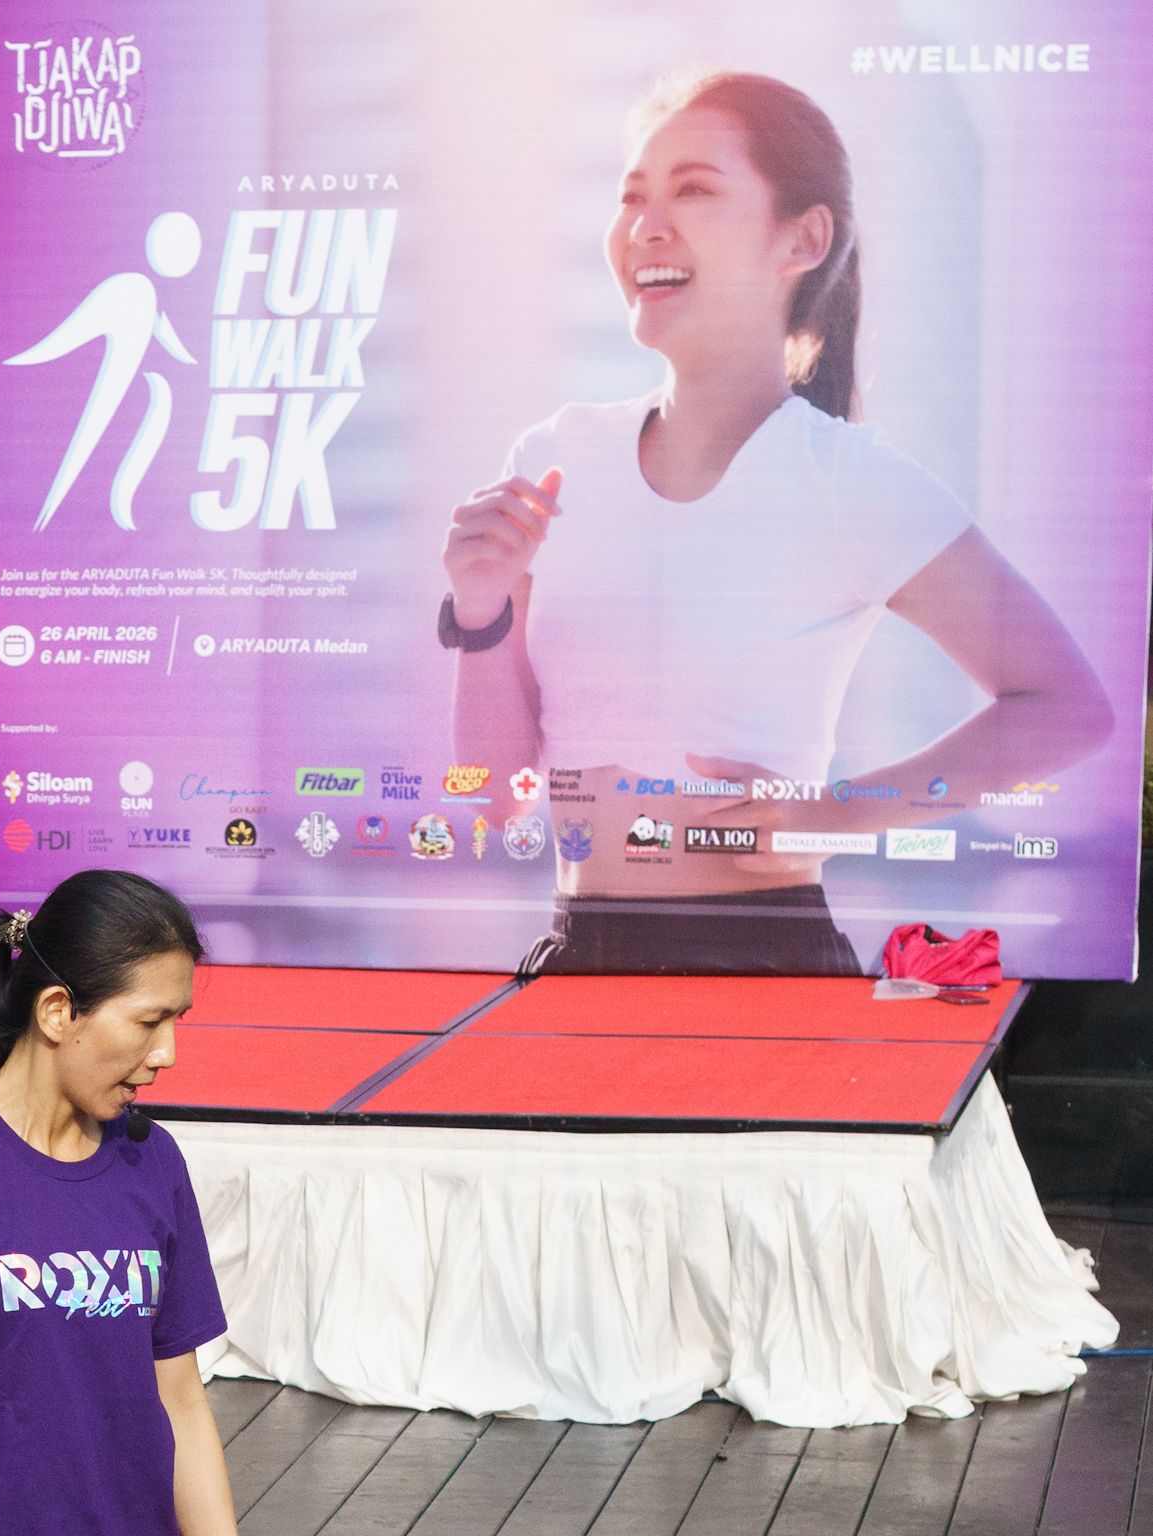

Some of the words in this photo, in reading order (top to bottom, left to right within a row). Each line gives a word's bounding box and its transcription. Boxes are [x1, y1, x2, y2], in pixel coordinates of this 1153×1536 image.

[4, 35, 141, 98] TJAKAP
[850, 44, 1090, 74] #WELLNICE
[237, 173, 400, 192] ARYADUTA
[212, 208, 398, 316] FUN
[209, 317, 377, 389] WALK
[189, 392, 361, 532] 5K
[0, 568, 24, 581] Join
[26, 570, 39, 581] us
[41, 568, 58, 582] for
[60, 568, 79, 581] the
[81, 568, 149, 581] ARYADUTA
[151, 568, 174, 580] Fun
[177, 568, 206, 580] Walk
[232, 568, 304, 582] Thoughtfully
[305, 568, 358, 582] designed
[0, 585, 13, 596] to
[15, 584, 62, 598] energize
[64, 587, 90, 598] your
[126, 584, 166, 597] refresh
[168, 586, 194, 598] your
[230, 584, 253, 596] and
[255, 584, 285, 598] uplift
[288, 587, 315, 598] your
[40, 626, 63, 641] 26
[64, 626, 112, 641] APRIL
[115, 626, 158, 641] 2026
[220, 638, 311, 653] ARYADUTA
[314, 638, 368, 653] Medan
[40, 649, 52, 664] 6
[53, 649, 82, 664] AM
[93, 649, 150, 664] FINISH
[1, 723, 44, 734] Supported
[448, 765, 490, 779] Hydro
[549, 768, 582, 778] Palang
[26, 771, 93, 792] Siloam
[180, 774, 276, 804] Champion
[300, 772, 360, 791] Fitbar
[445, 777, 484, 793] Coco
[549, 781, 579, 790] Merah
[636, 779, 675, 795] BCA
[752, 778, 826, 800] ROXIT
[26, 793, 60, 805] Dhirga
[63, 793, 91, 805] Surya
[382, 787, 420, 800] Milk
[549, 793, 596, 802] Indonesia
[980, 790, 1043, 806] mandiri
[120, 797, 153, 810] SUN
[38, 830, 71, 850] HDI
[143, 829, 191, 842] YUKE
[312, 815, 323, 850] LEO
[687, 828, 721, 846] PIA
[724, 829, 756, 847] 100
[1016, 834, 1056, 855] im3
